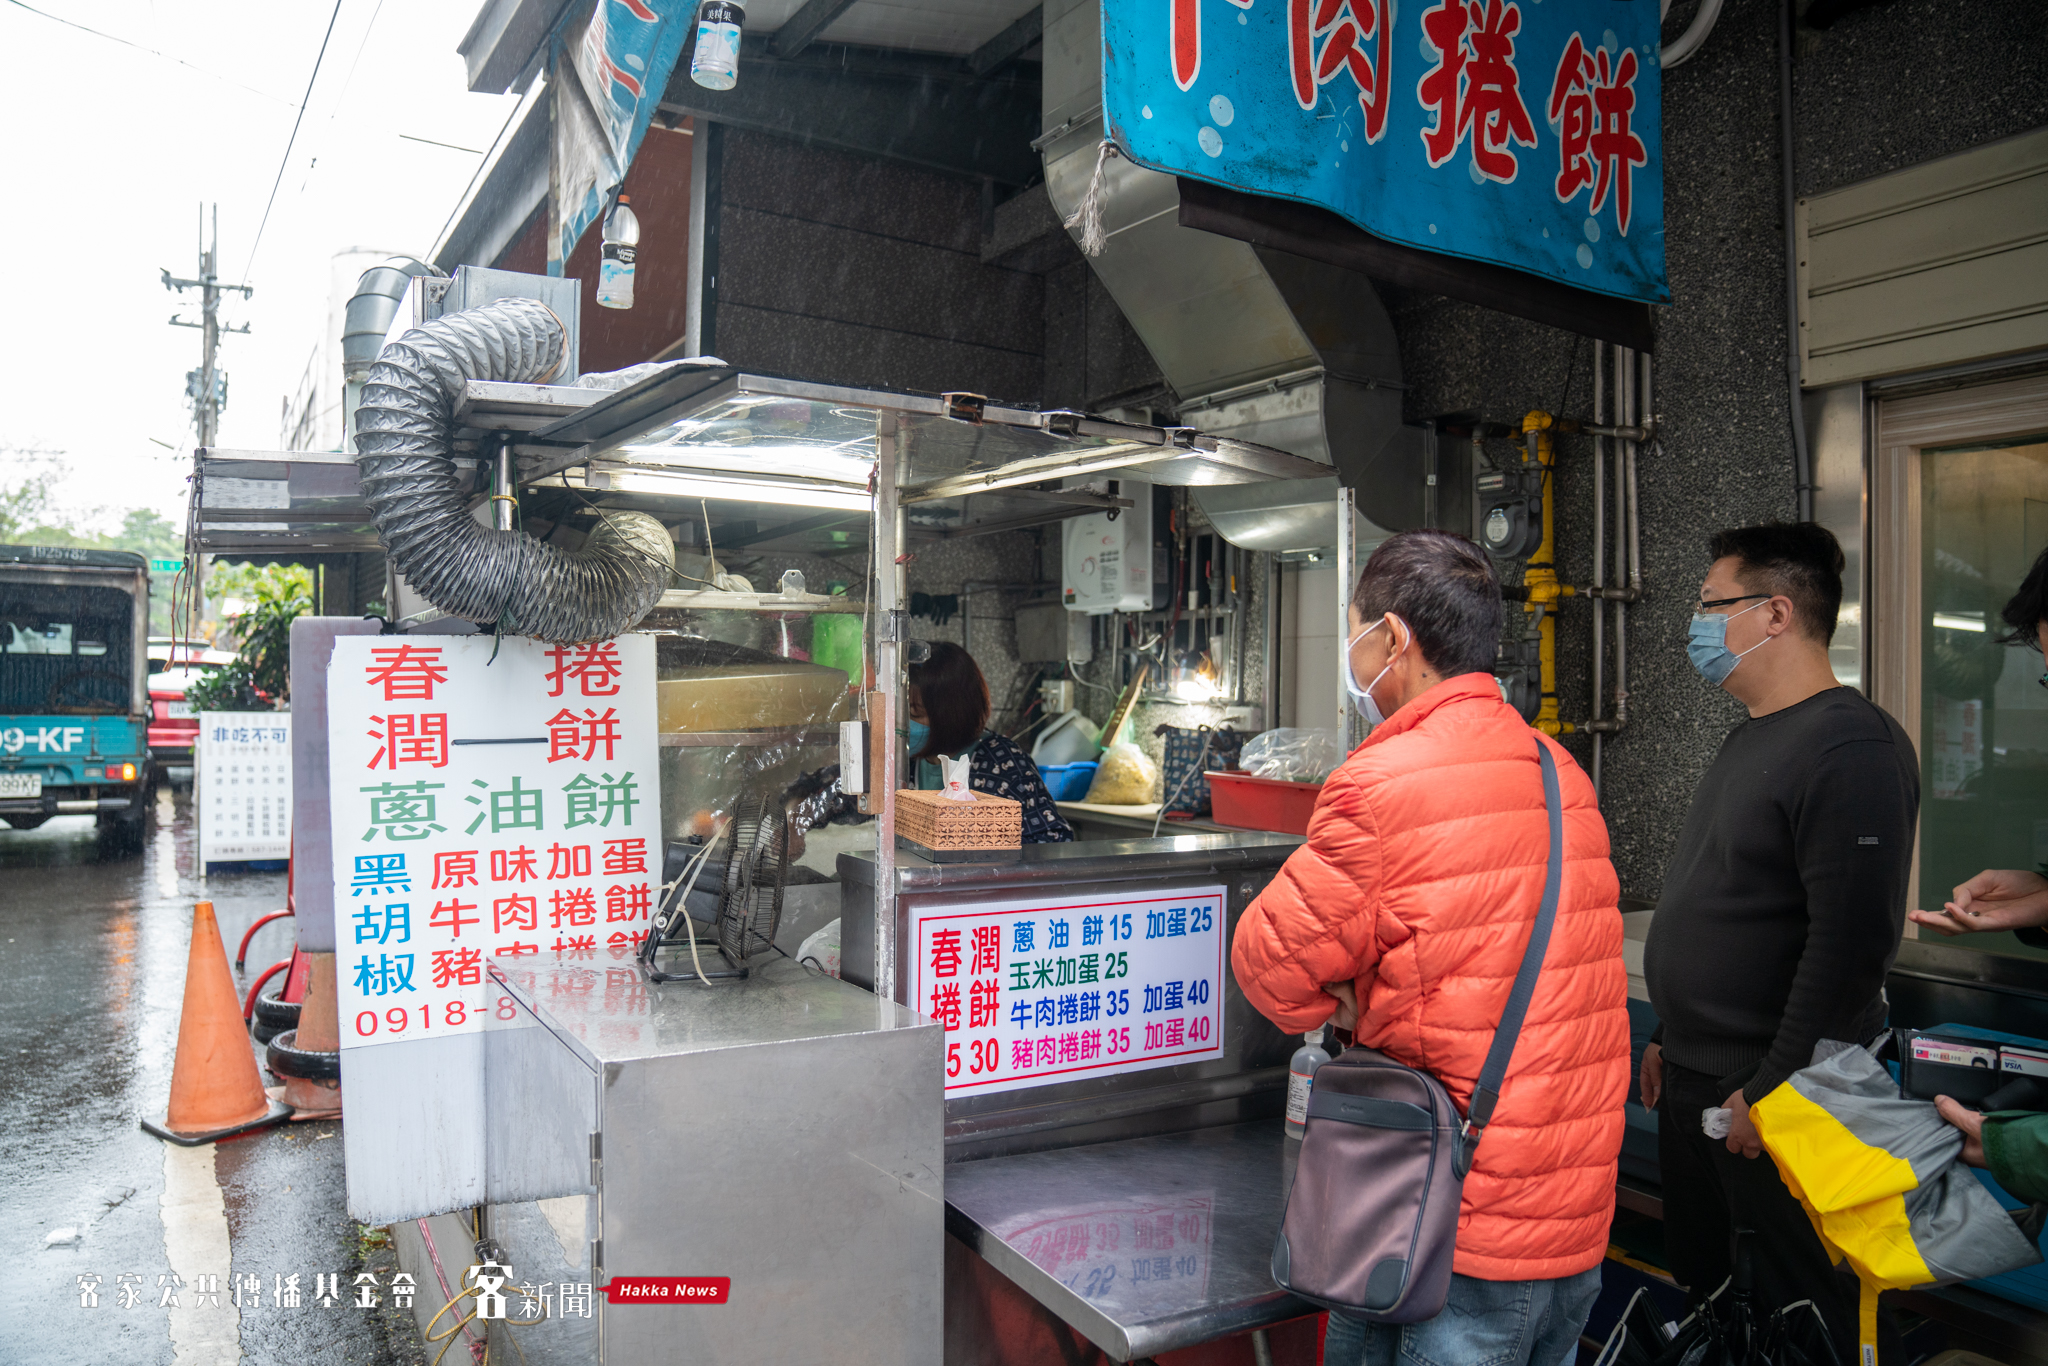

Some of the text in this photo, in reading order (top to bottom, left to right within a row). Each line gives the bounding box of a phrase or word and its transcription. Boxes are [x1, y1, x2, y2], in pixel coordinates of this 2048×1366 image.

[1171, 0, 1647, 237] 肉捲餅
[0, 727, 84, 753] 9-KF
[212, 726, 287, 743] 非吃不可
[360, 771, 640, 842] 蔥油餅
[431, 838, 648, 890] 原味加蛋
[350, 853, 417, 996] 黑胡椒
[429, 883, 652, 938] 牛肉捲餅
[969, 1038, 999, 1074] 30
